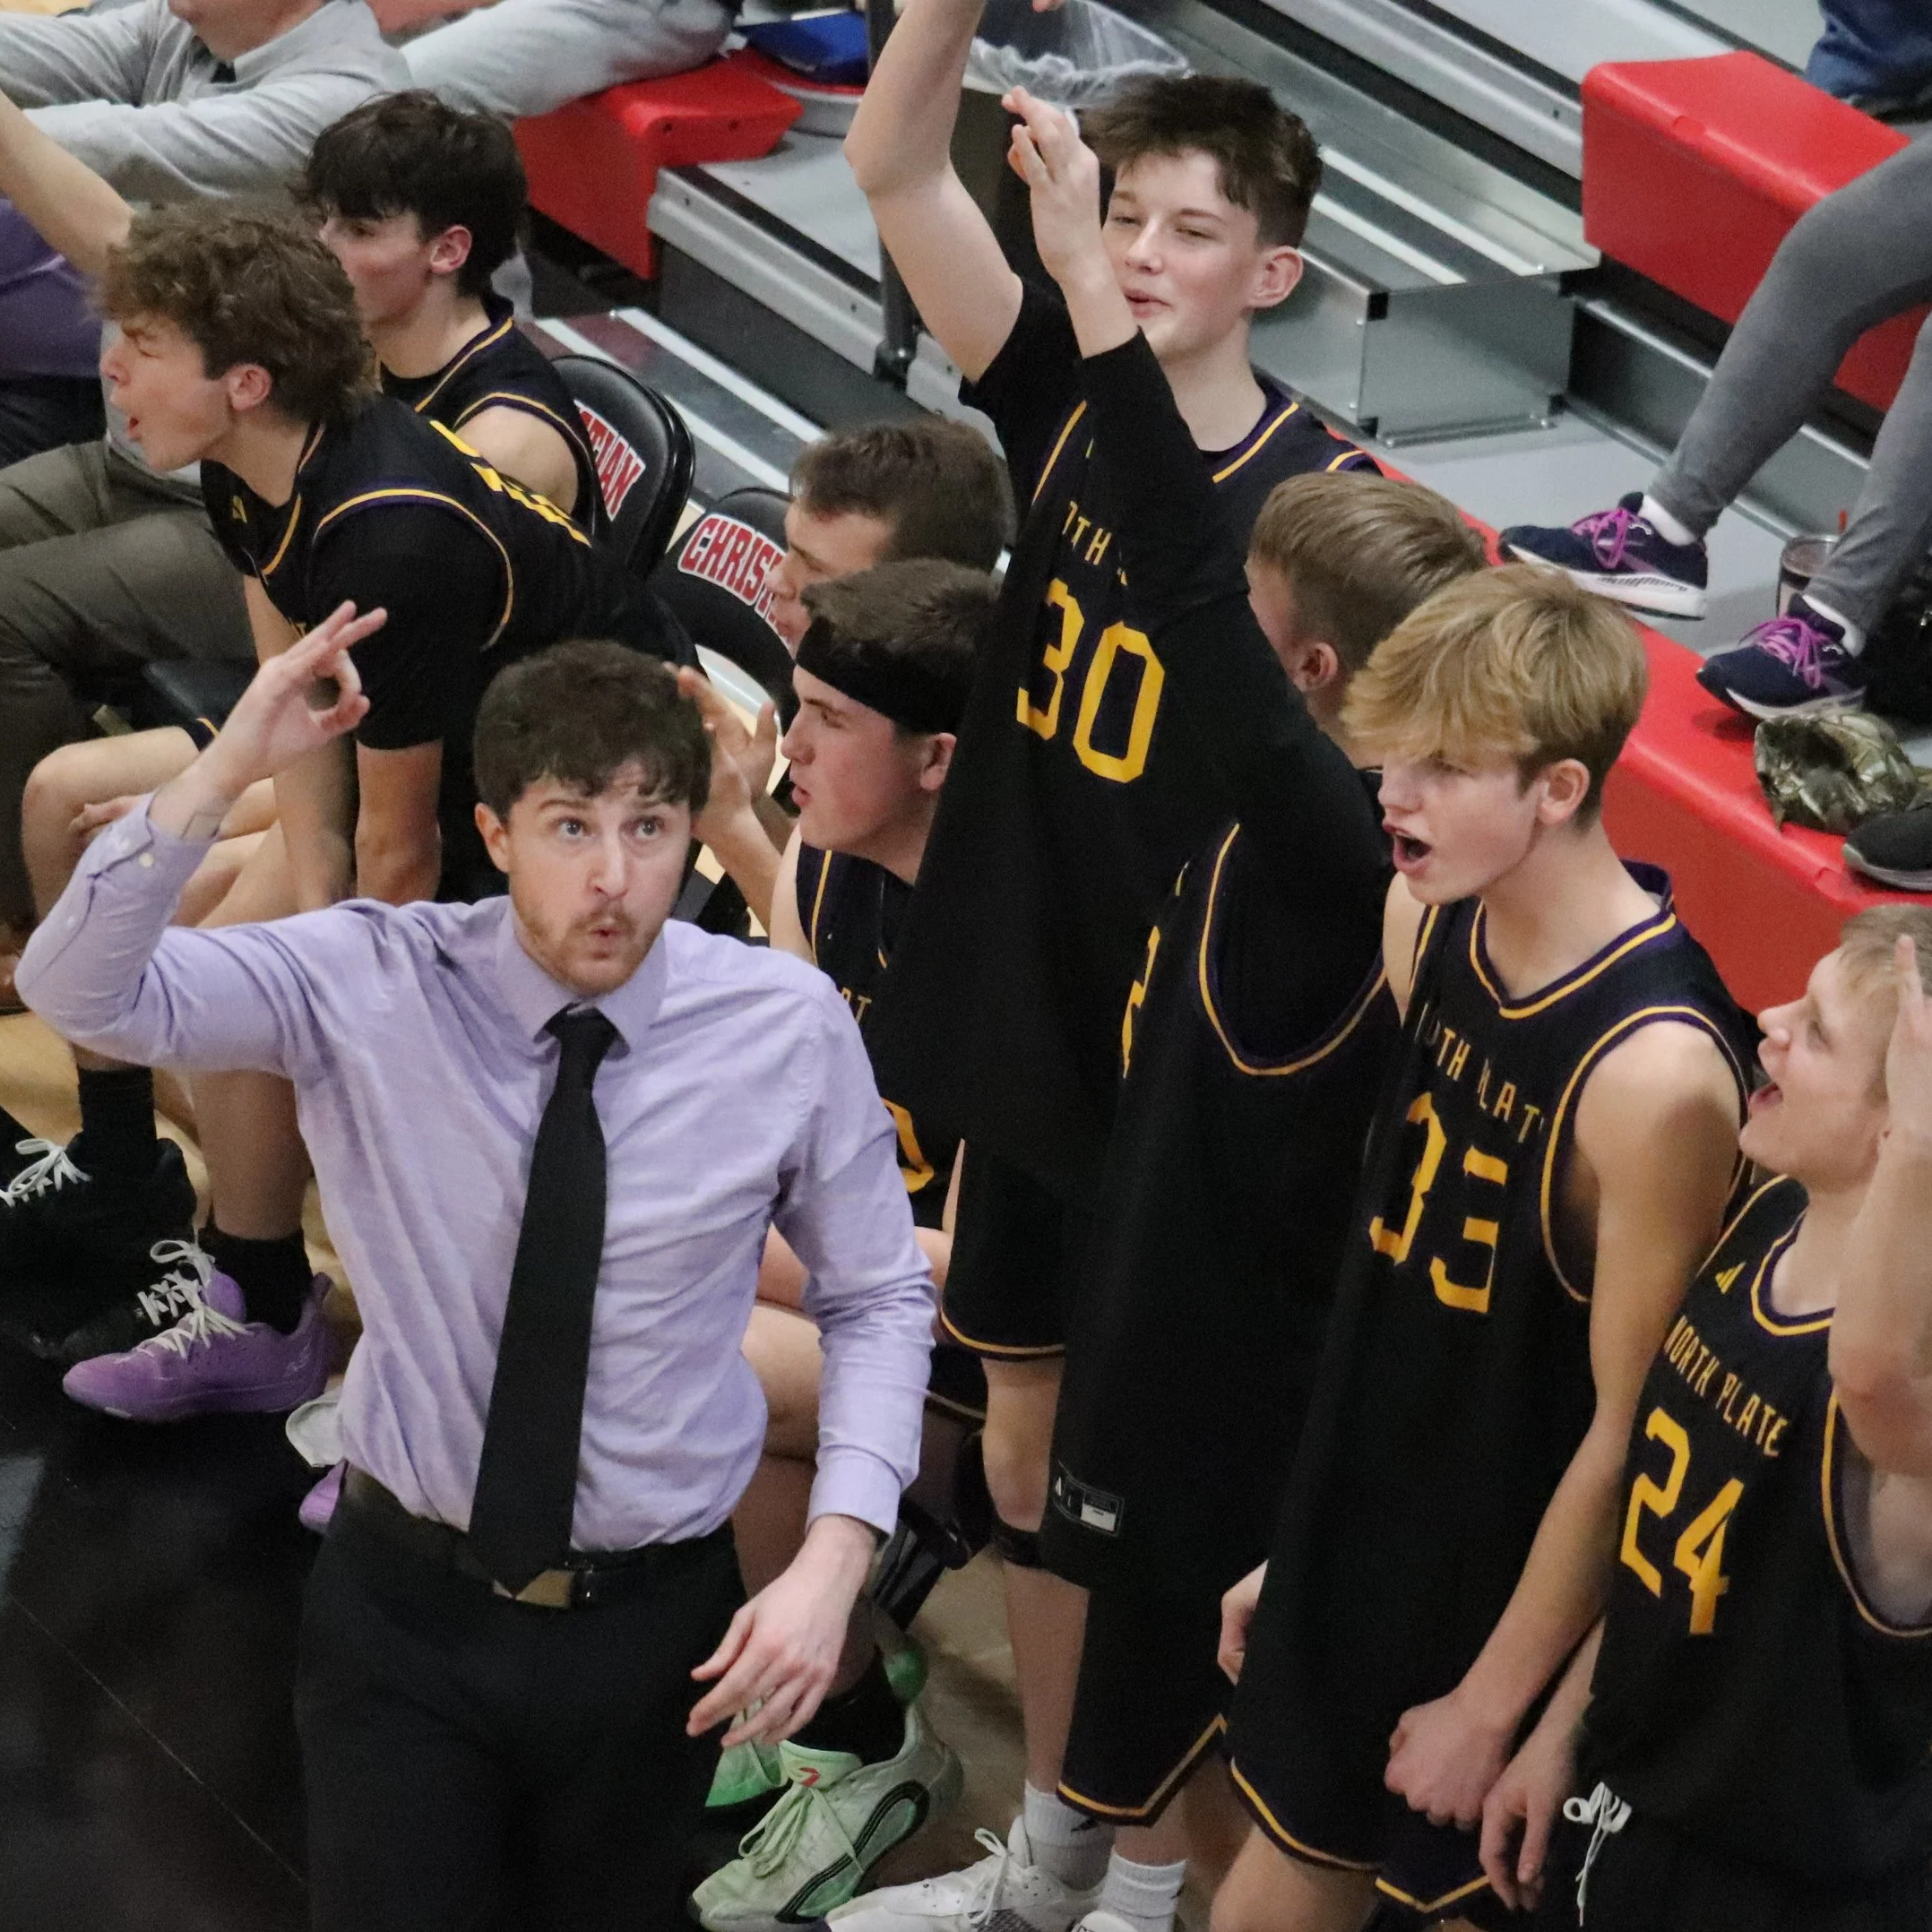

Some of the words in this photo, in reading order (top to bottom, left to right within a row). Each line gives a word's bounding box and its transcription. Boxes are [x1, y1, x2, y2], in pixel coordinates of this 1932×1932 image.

[1016, 578, 1165, 783] 30
[1663, 1315, 1720, 1397] NORTH
[1715, 1372, 1788, 1457] PLATE
[1620, 1406, 1744, 1634] 24
